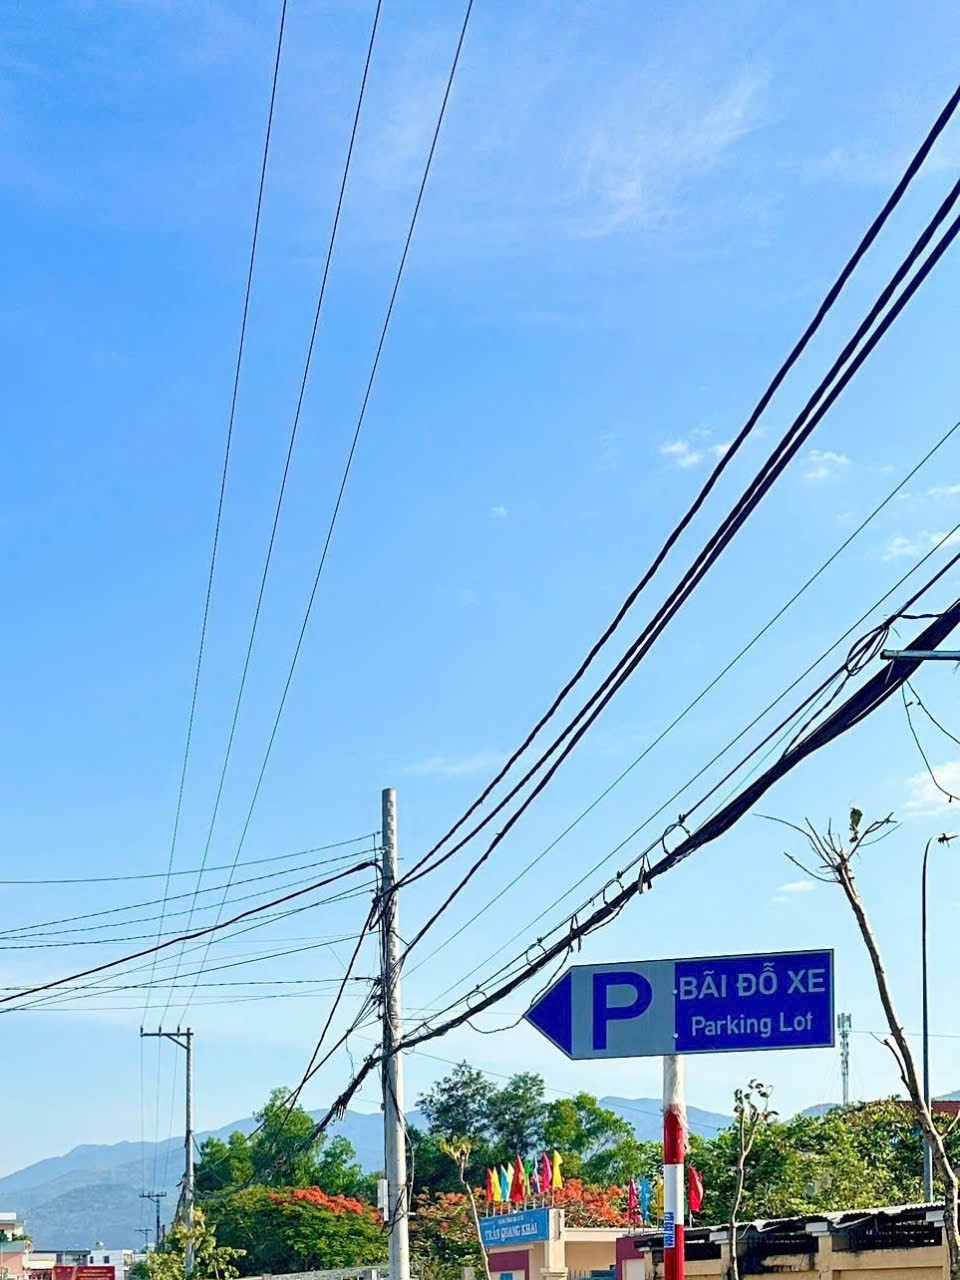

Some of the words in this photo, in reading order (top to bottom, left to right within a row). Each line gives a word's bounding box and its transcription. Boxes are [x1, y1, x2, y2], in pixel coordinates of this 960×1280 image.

[679, 970, 727, 1000] BÃI
[736, 961, 778, 997] ĐỖ
[787, 968, 826, 994] XE
[592, 971, 653, 1050] P
[691, 1014, 772, 1038] Parking
[779, 1011, 813, 1032] Lot
